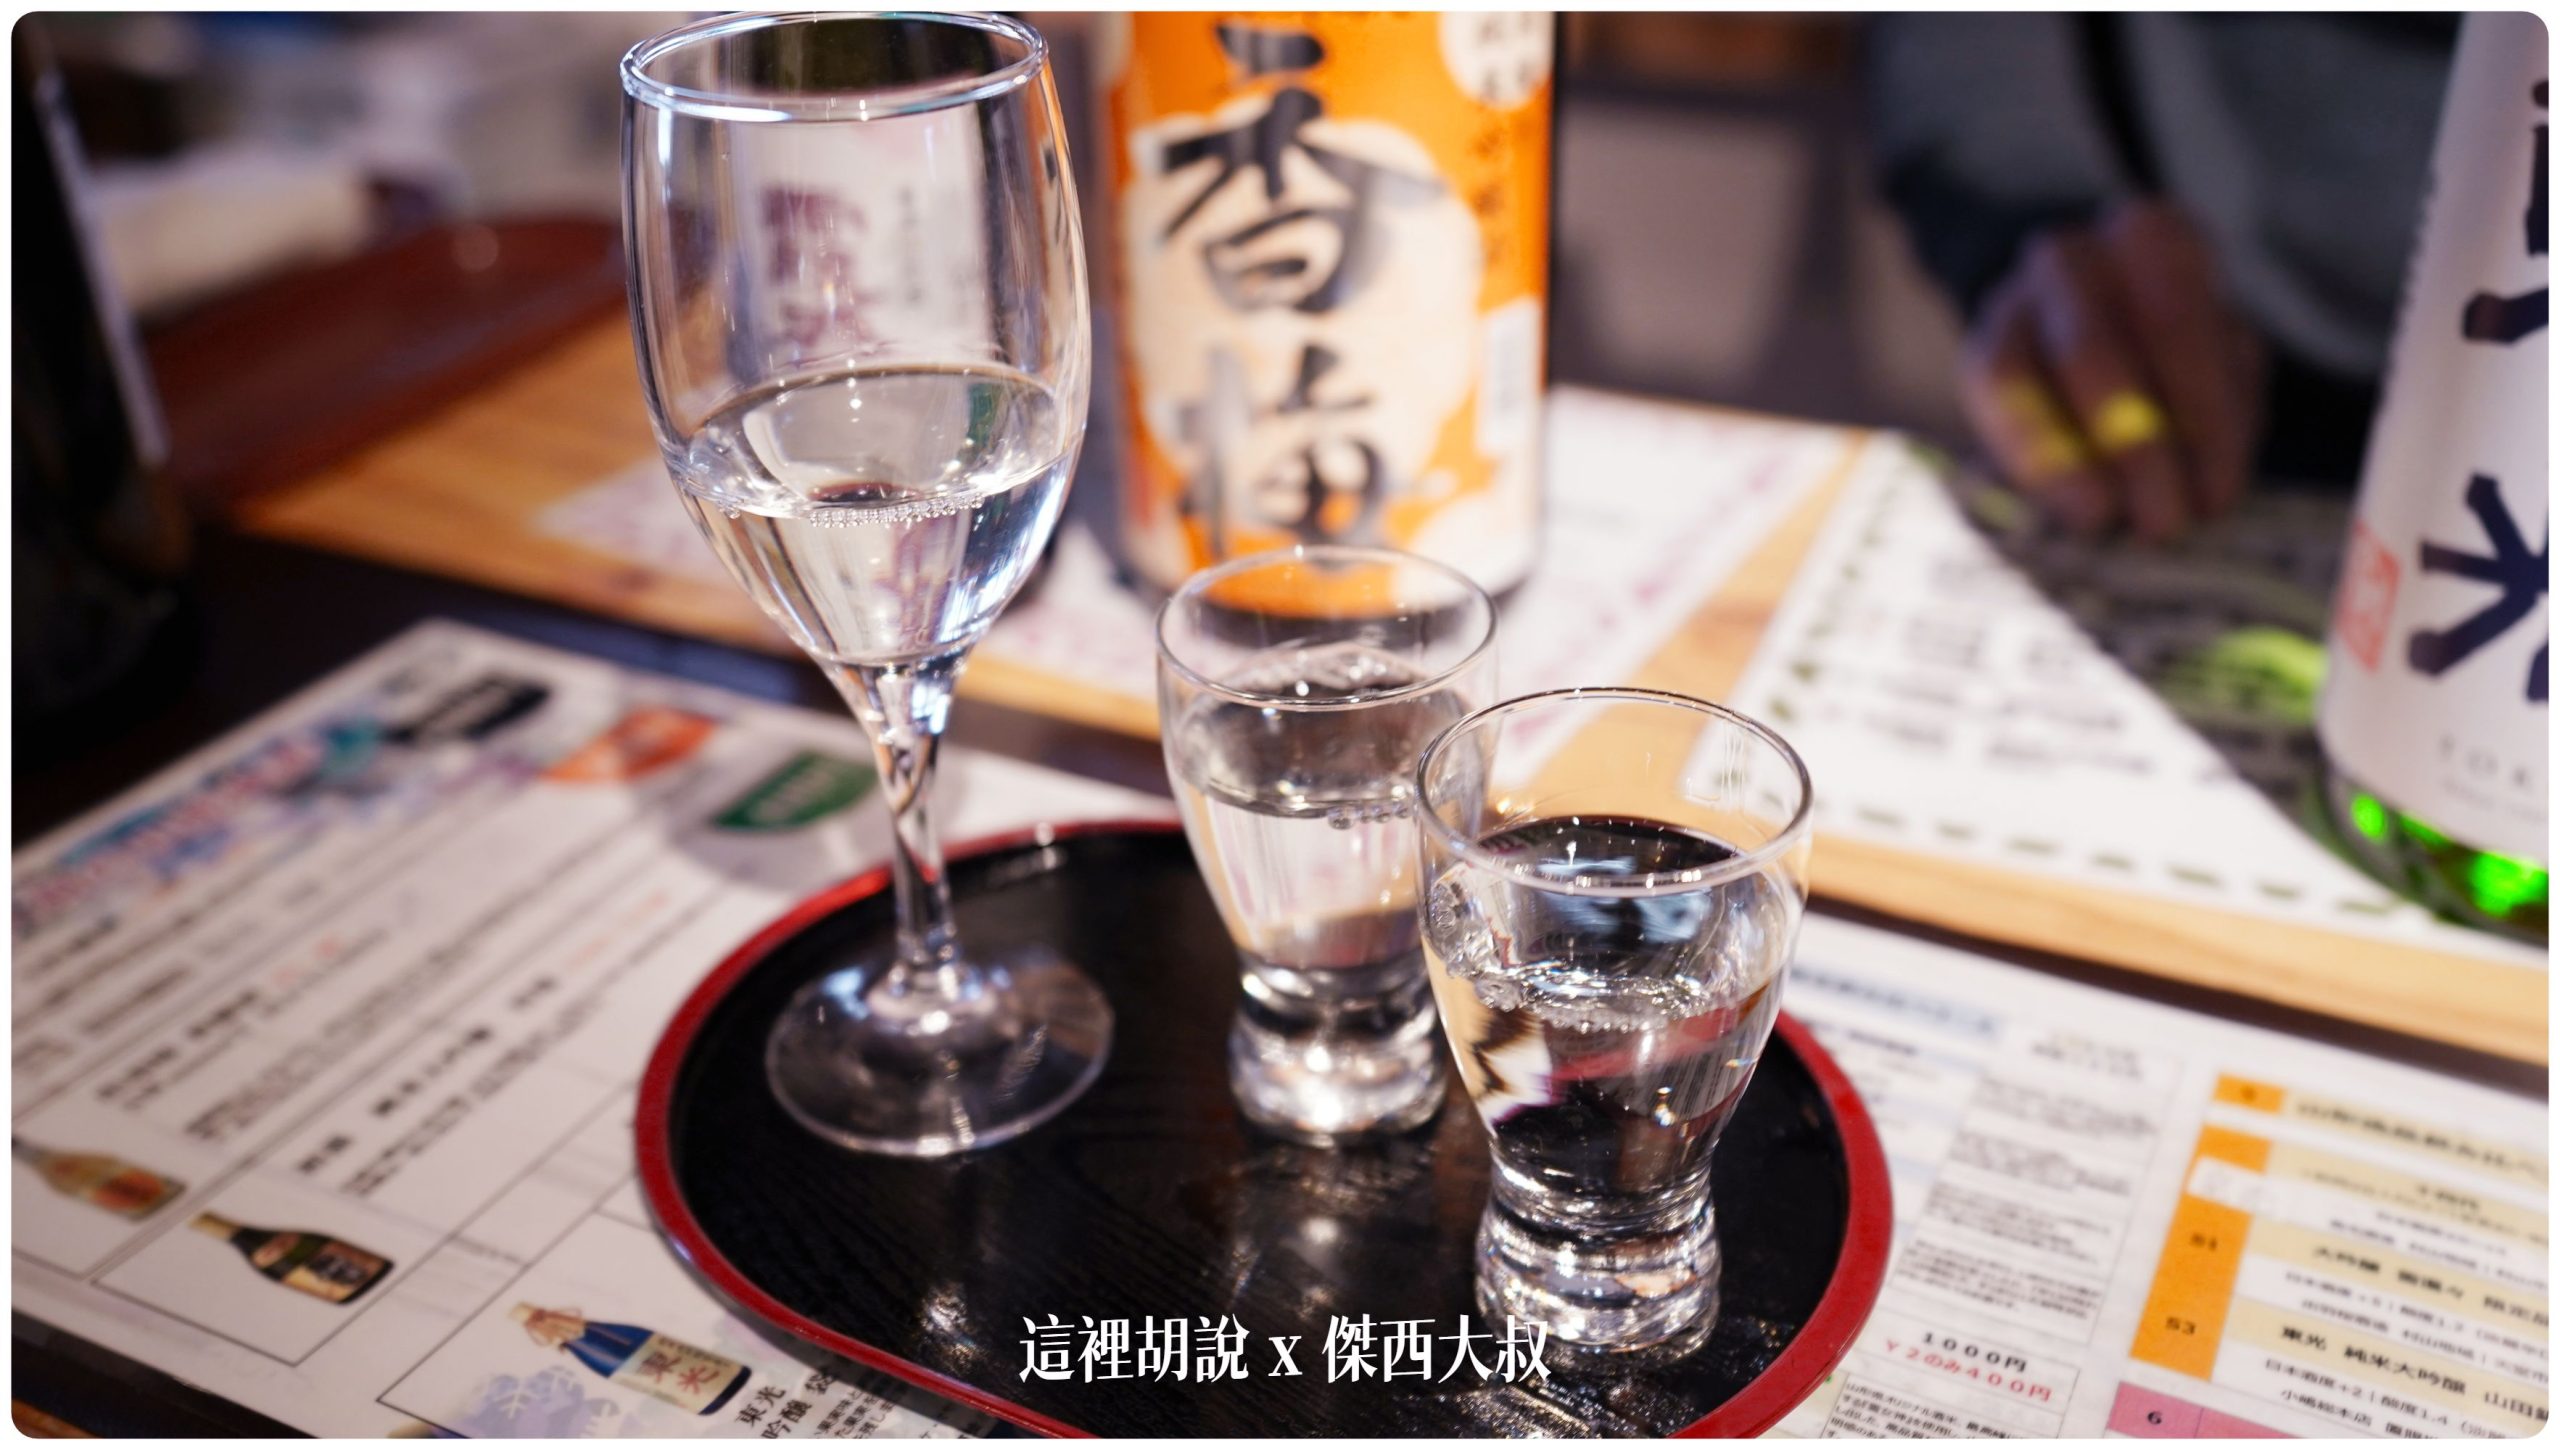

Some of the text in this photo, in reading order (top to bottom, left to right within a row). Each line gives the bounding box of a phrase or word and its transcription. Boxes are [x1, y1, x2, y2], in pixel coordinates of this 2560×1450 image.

[2281, 1326, 2327, 1352] 東光
[2344, 1346, 2466, 1395] 純米大吟醸
[736, 1386, 786, 1427] 東光
[2147, 1411, 2162, 1426] 6
